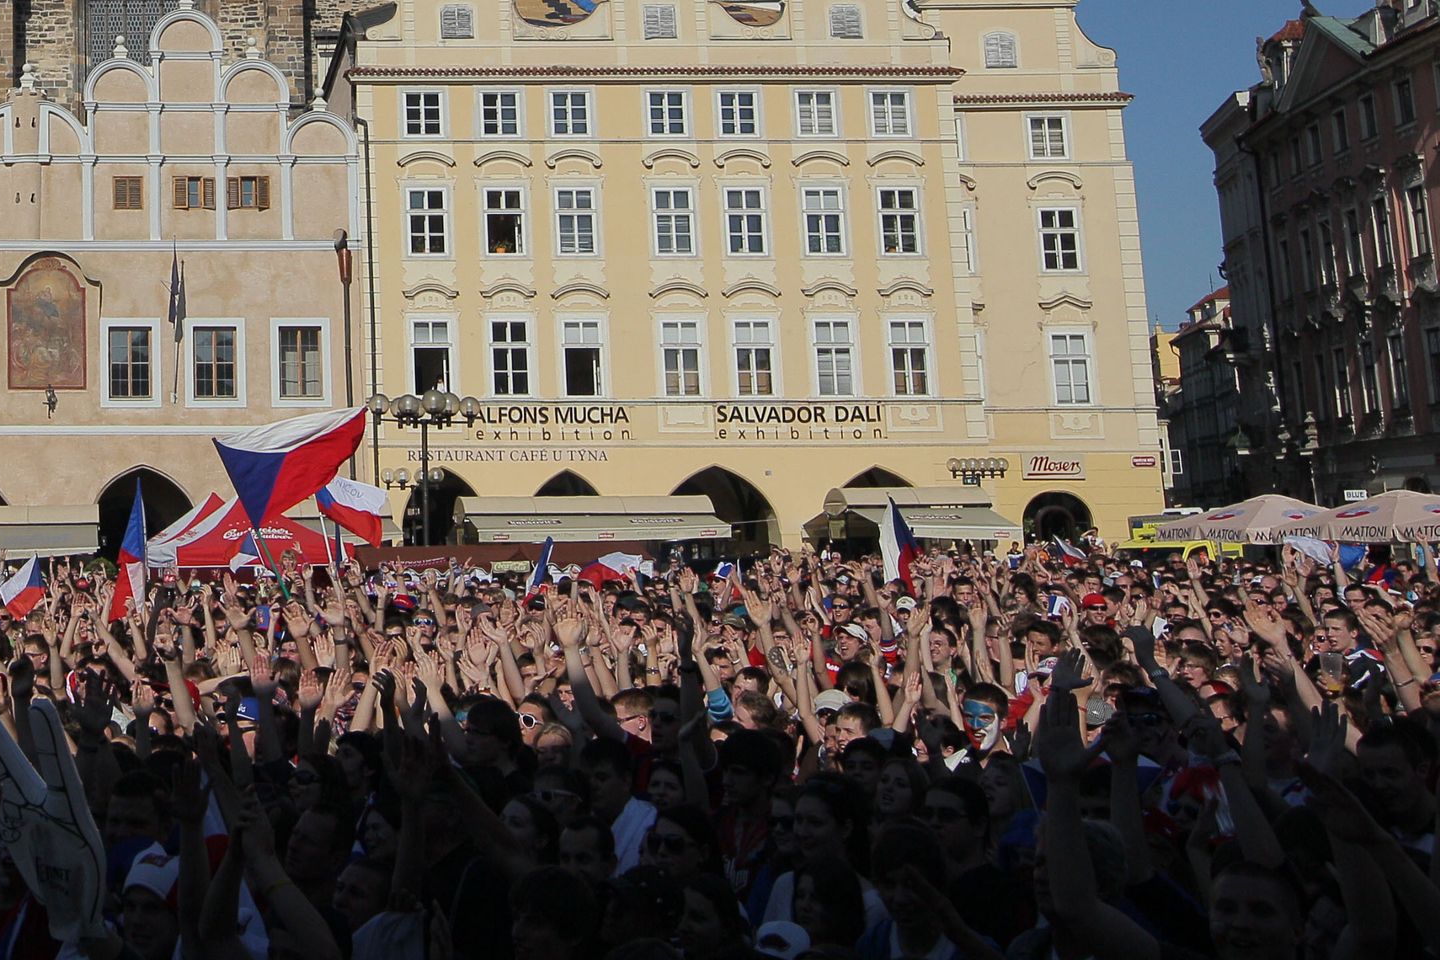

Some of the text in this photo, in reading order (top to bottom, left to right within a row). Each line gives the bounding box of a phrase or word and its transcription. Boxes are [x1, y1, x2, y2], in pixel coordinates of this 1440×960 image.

[475, 406, 629, 424] ALFONS MUCHA
[716, 405, 826, 423] SALVADOR
[475, 427, 631, 441] exhibition
[718, 427, 883, 440] exhibition
[407, 449, 506, 462] RESTAURANT
[510, 448, 548, 462] CAFÉ
[553, 450, 563, 462] U
[1029, 456, 1082, 475] Moser
[1346, 491, 1366, 499] BLUE
[1342, 526, 1387, 538] MATTONI
